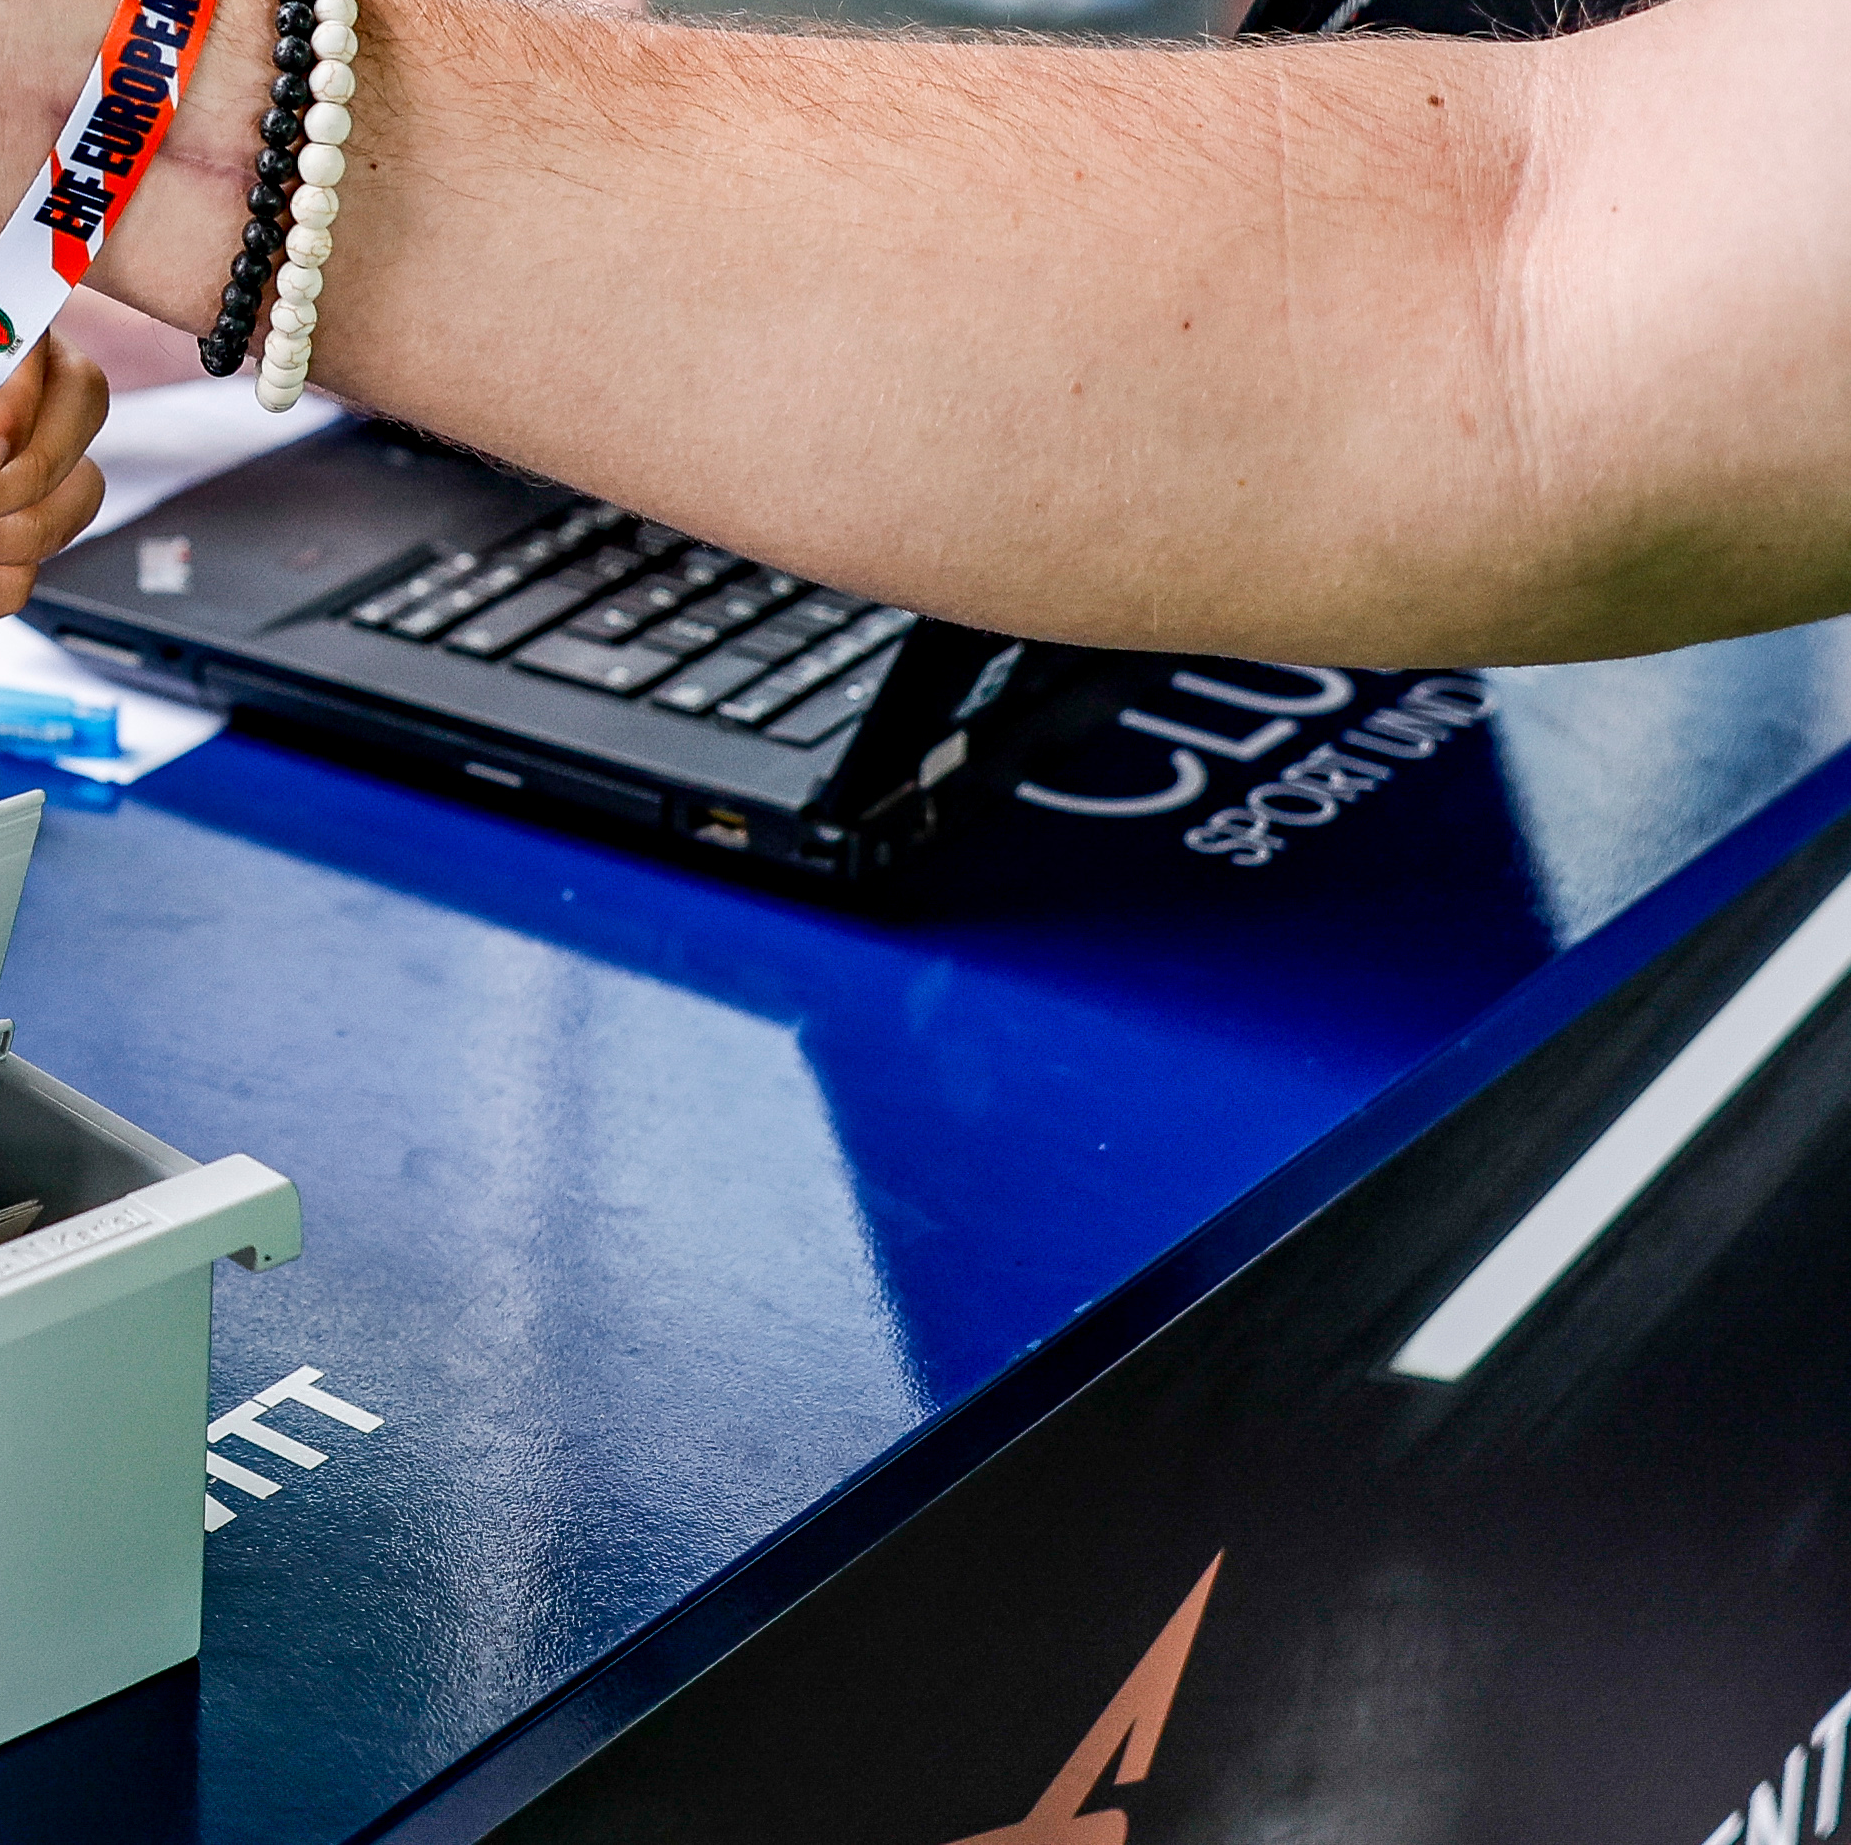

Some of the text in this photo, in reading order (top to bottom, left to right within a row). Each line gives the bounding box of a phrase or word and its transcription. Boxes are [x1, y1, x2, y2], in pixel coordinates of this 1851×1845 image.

[34, 161, 113, 242] EHF
[1184, 743, 1394, 866] SPORT
[1701, 1689, 1851, 1845] NT
